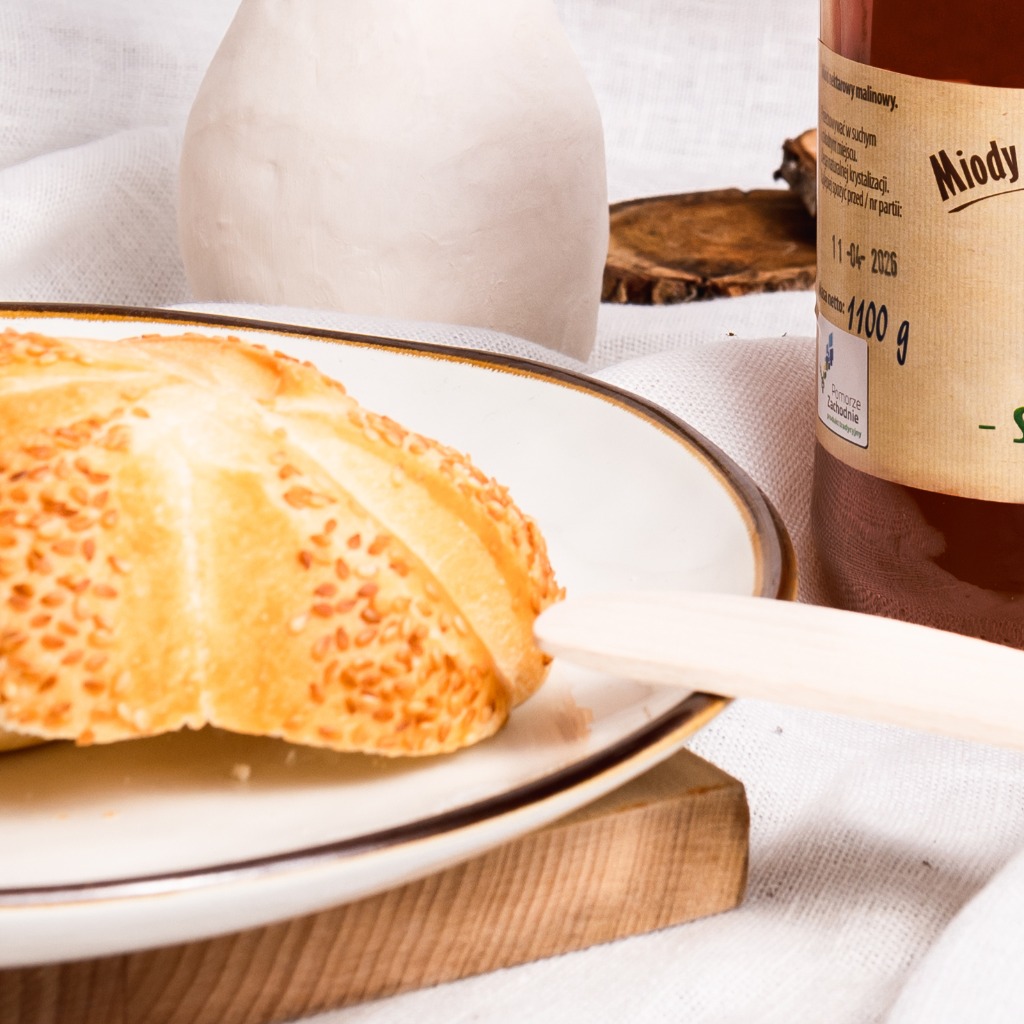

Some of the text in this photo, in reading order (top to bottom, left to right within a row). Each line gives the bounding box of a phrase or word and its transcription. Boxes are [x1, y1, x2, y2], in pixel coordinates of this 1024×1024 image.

[855, 84, 898, 112] malinowy.
[852, 126, 877, 149] suchym
[929, 140, 1019, 202] Miody
[871, 248, 898, 278] 2026
[847, 296, 888, 342] 1100
[896, 320, 910, 366] g
[827, 394, 859, 425] Zachodnie
[831, 383, 862, 411] Pomorze
